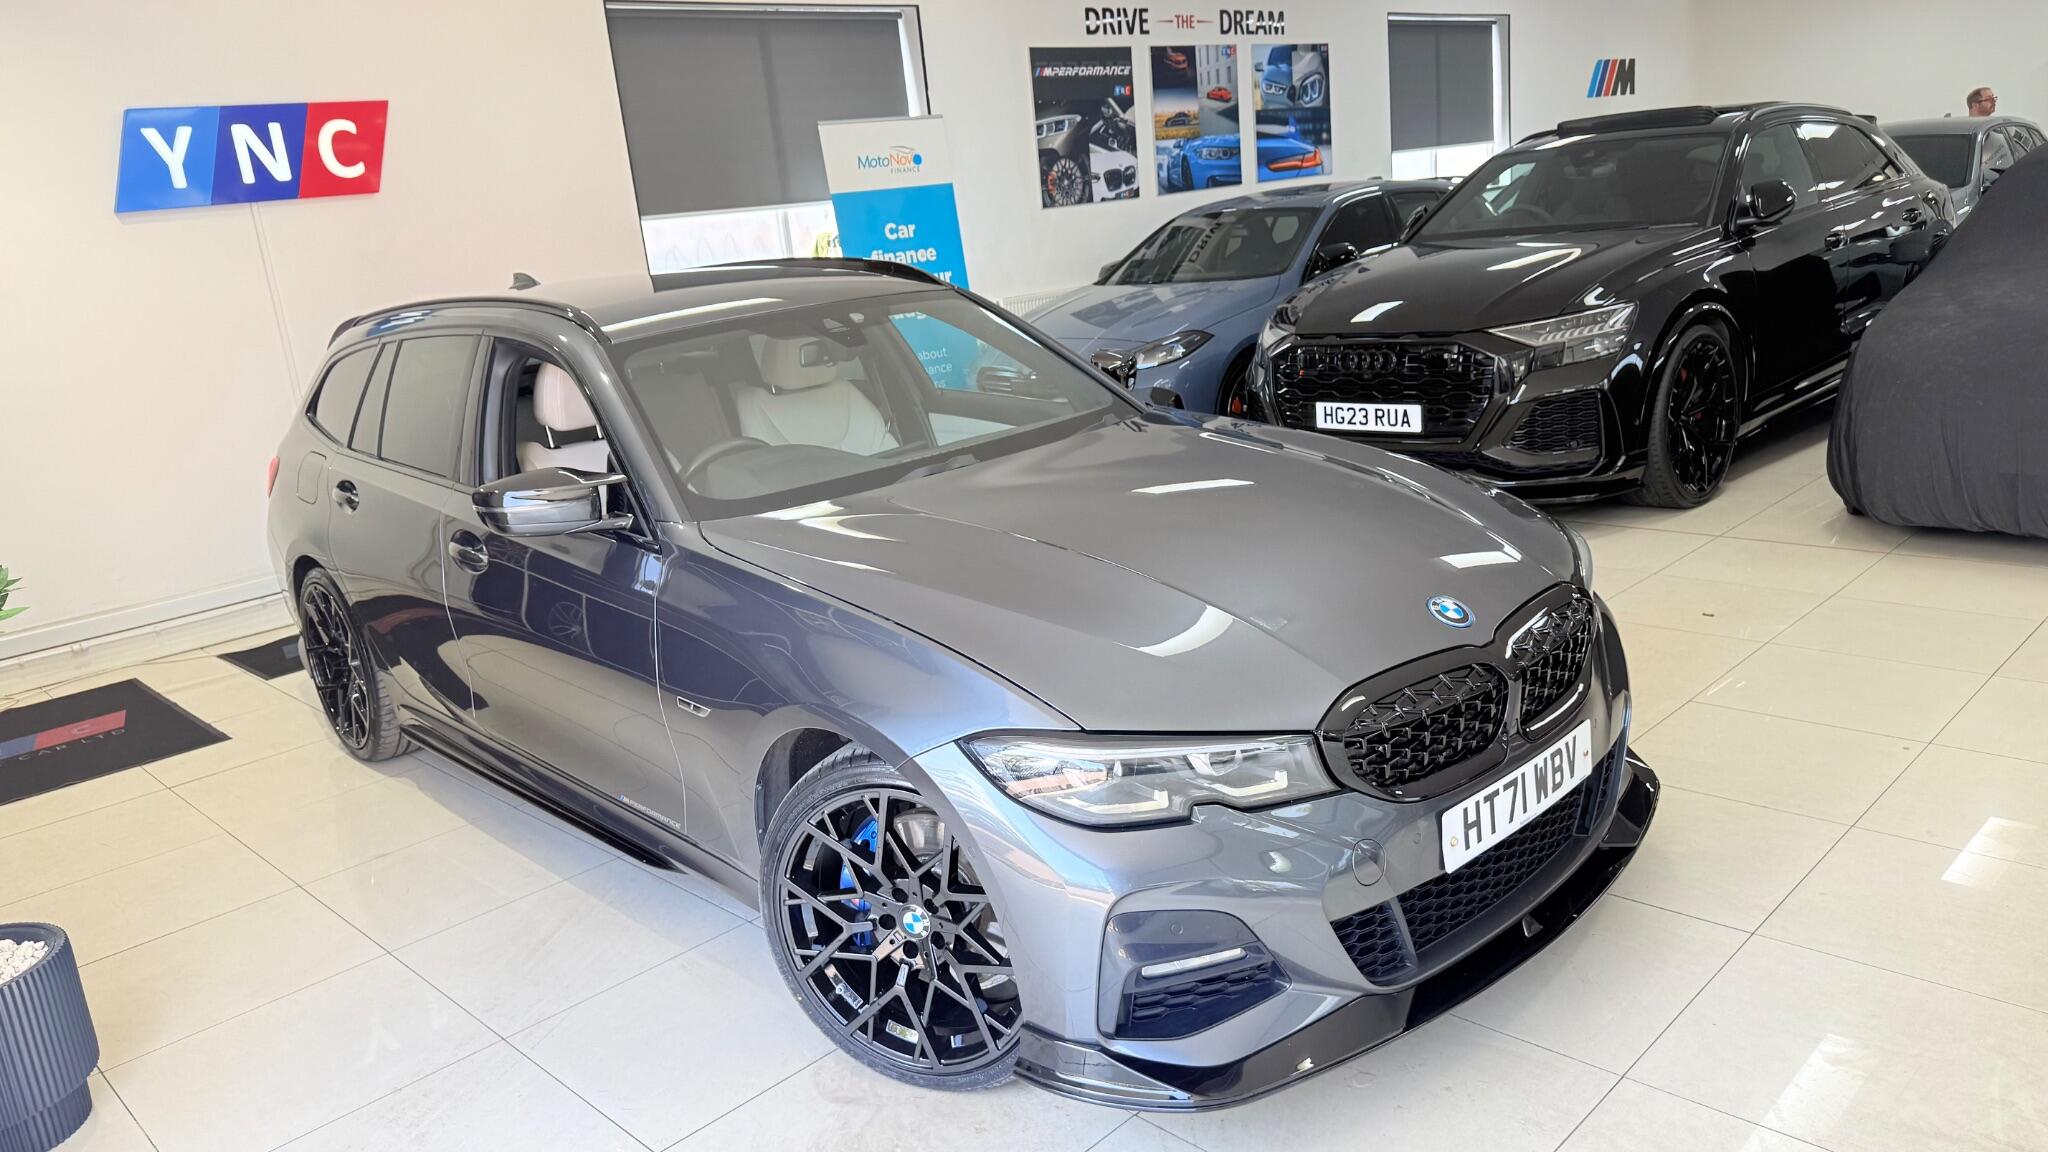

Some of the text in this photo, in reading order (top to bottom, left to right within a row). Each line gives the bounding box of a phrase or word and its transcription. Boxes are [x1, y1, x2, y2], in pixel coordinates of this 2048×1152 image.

[1085, 7, 1285, 35] DRIVE THE DREAM
[140, 118, 366, 189] YNC
[890, 167, 921, 175] FINANCE
[884, 222, 916, 240] Car
[1323, 406, 1411, 428] HG23 RUA
[1462, 736, 1578, 851] HT71 WBV
